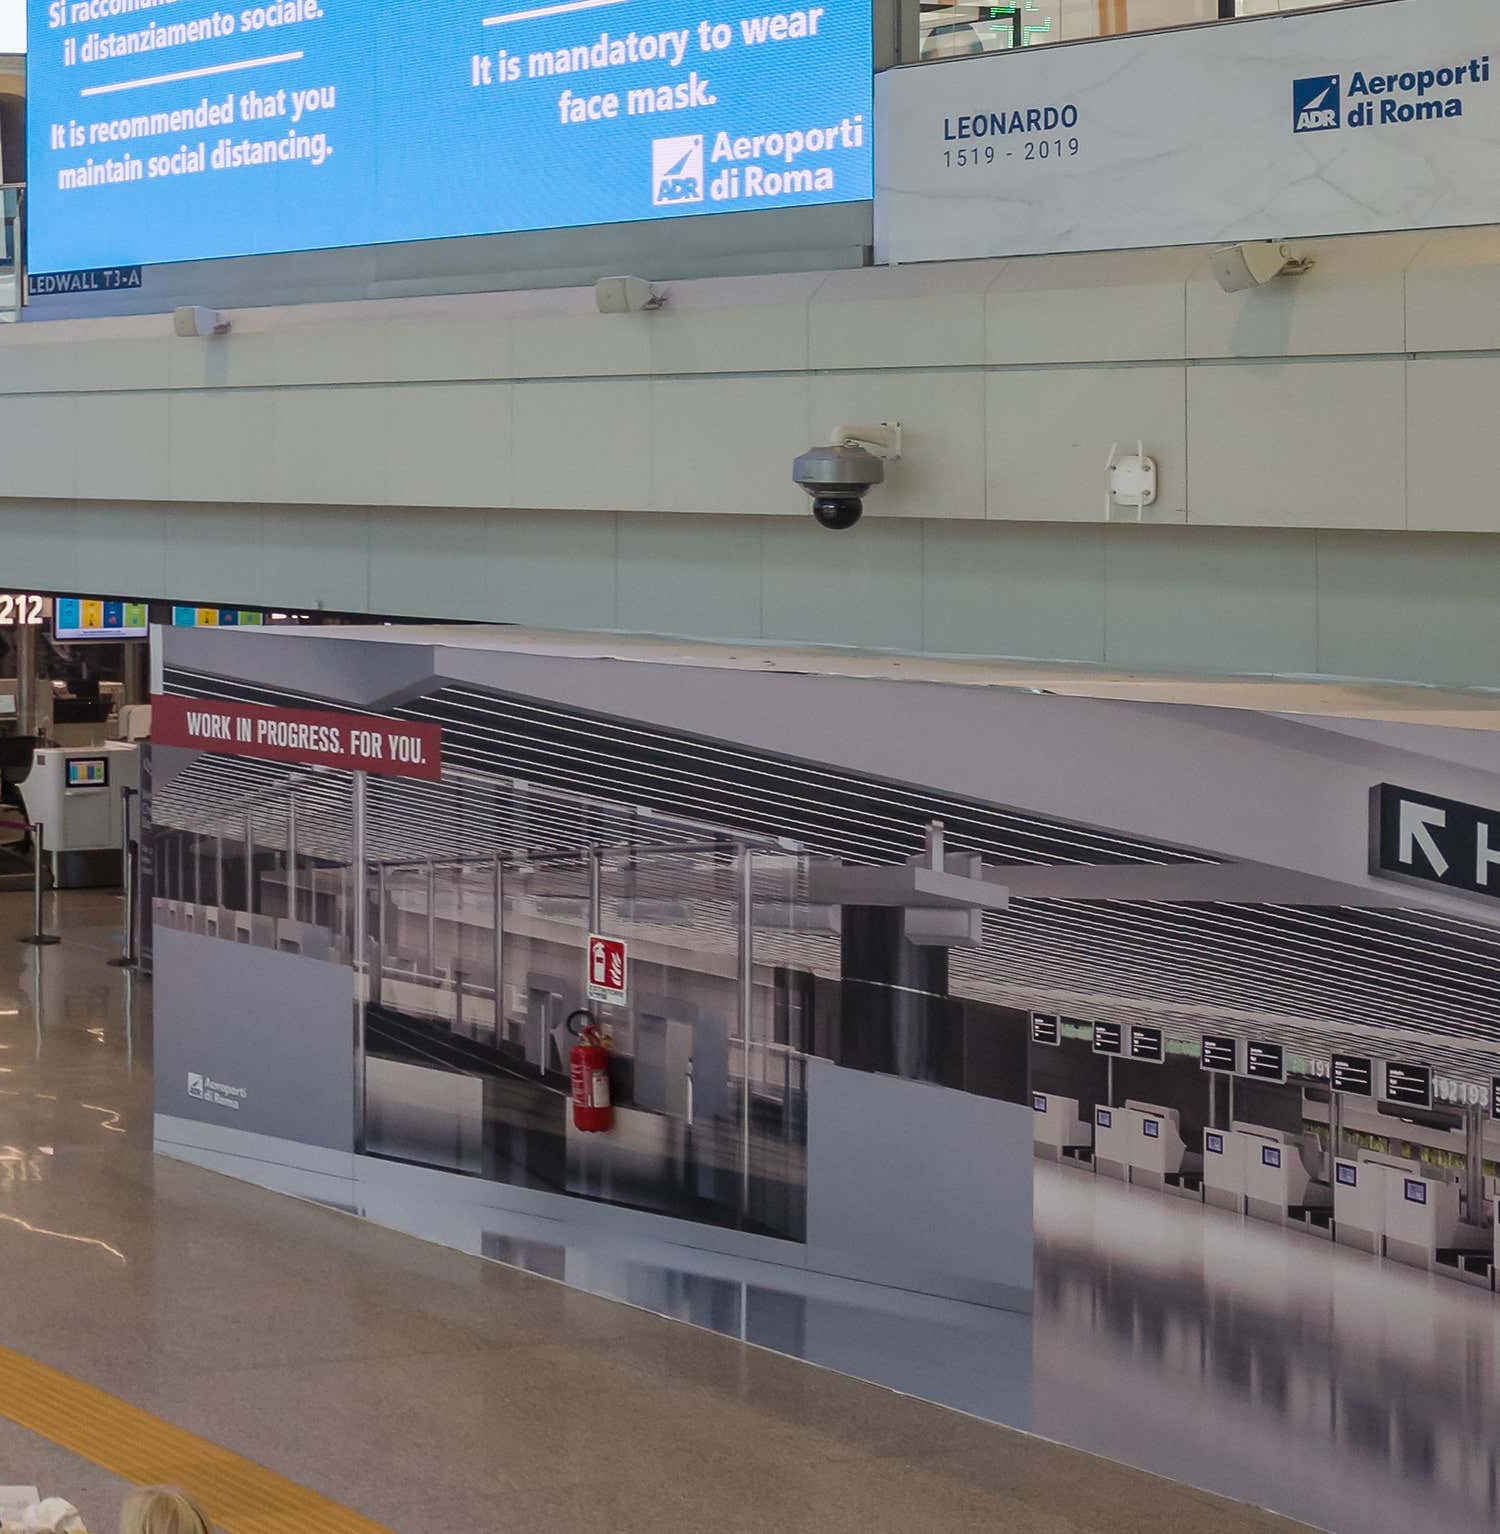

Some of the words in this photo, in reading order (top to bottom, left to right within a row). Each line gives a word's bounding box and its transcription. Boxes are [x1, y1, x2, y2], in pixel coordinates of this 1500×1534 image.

[48, 0, 66, 28] Si
[64, 38, 77, 66] il
[81, 12, 235, 63] distanziamento
[240, 0, 324, 32] sociale.
[472, 54, 492, 86] It
[498, 49, 521, 82] is
[528, 29, 689, 78] mandatory
[699, 20, 731, 52] to
[741, 7, 825, 46] wear
[1347, 56, 1490, 97] Aeroporti
[558, 89, 619, 124] face
[628, 71, 718, 116] mask.
[1348, 102, 1373, 129] di
[1380, 97, 1463, 126] Roma
[51, 123, 65, 150] It
[70, 120, 85, 147] is
[90, 94, 234, 145] recommended
[239, 89, 286, 121] that
[291, 86, 336, 123] you
[943, 104, 1079, 141] LEONARDO
[1296, 109, 1336, 129] ADR
[710, 115, 863, 164] Aeroporti
[943, 146, 995, 168] 1519
[1024, 137, 1080, 162] 2019
[58, 153, 144, 190] maintain
[148, 142, 205, 179] social
[210, 129, 334, 165] distancing.
[658, 176, 700, 201] ADR
[710, 169, 738, 200] di
[745, 165, 833, 197] Roma
[29, 269, 99, 295] LEDWALL
[104, 265, 141, 288] T3-A
[187, 711, 231, 740] WORK
[236, 717, 252, 743] IN
[257, 719, 345, 754] PROGRESS.
[350, 730, 383, 759] FOR
[388, 735, 426, 764] YOU.
